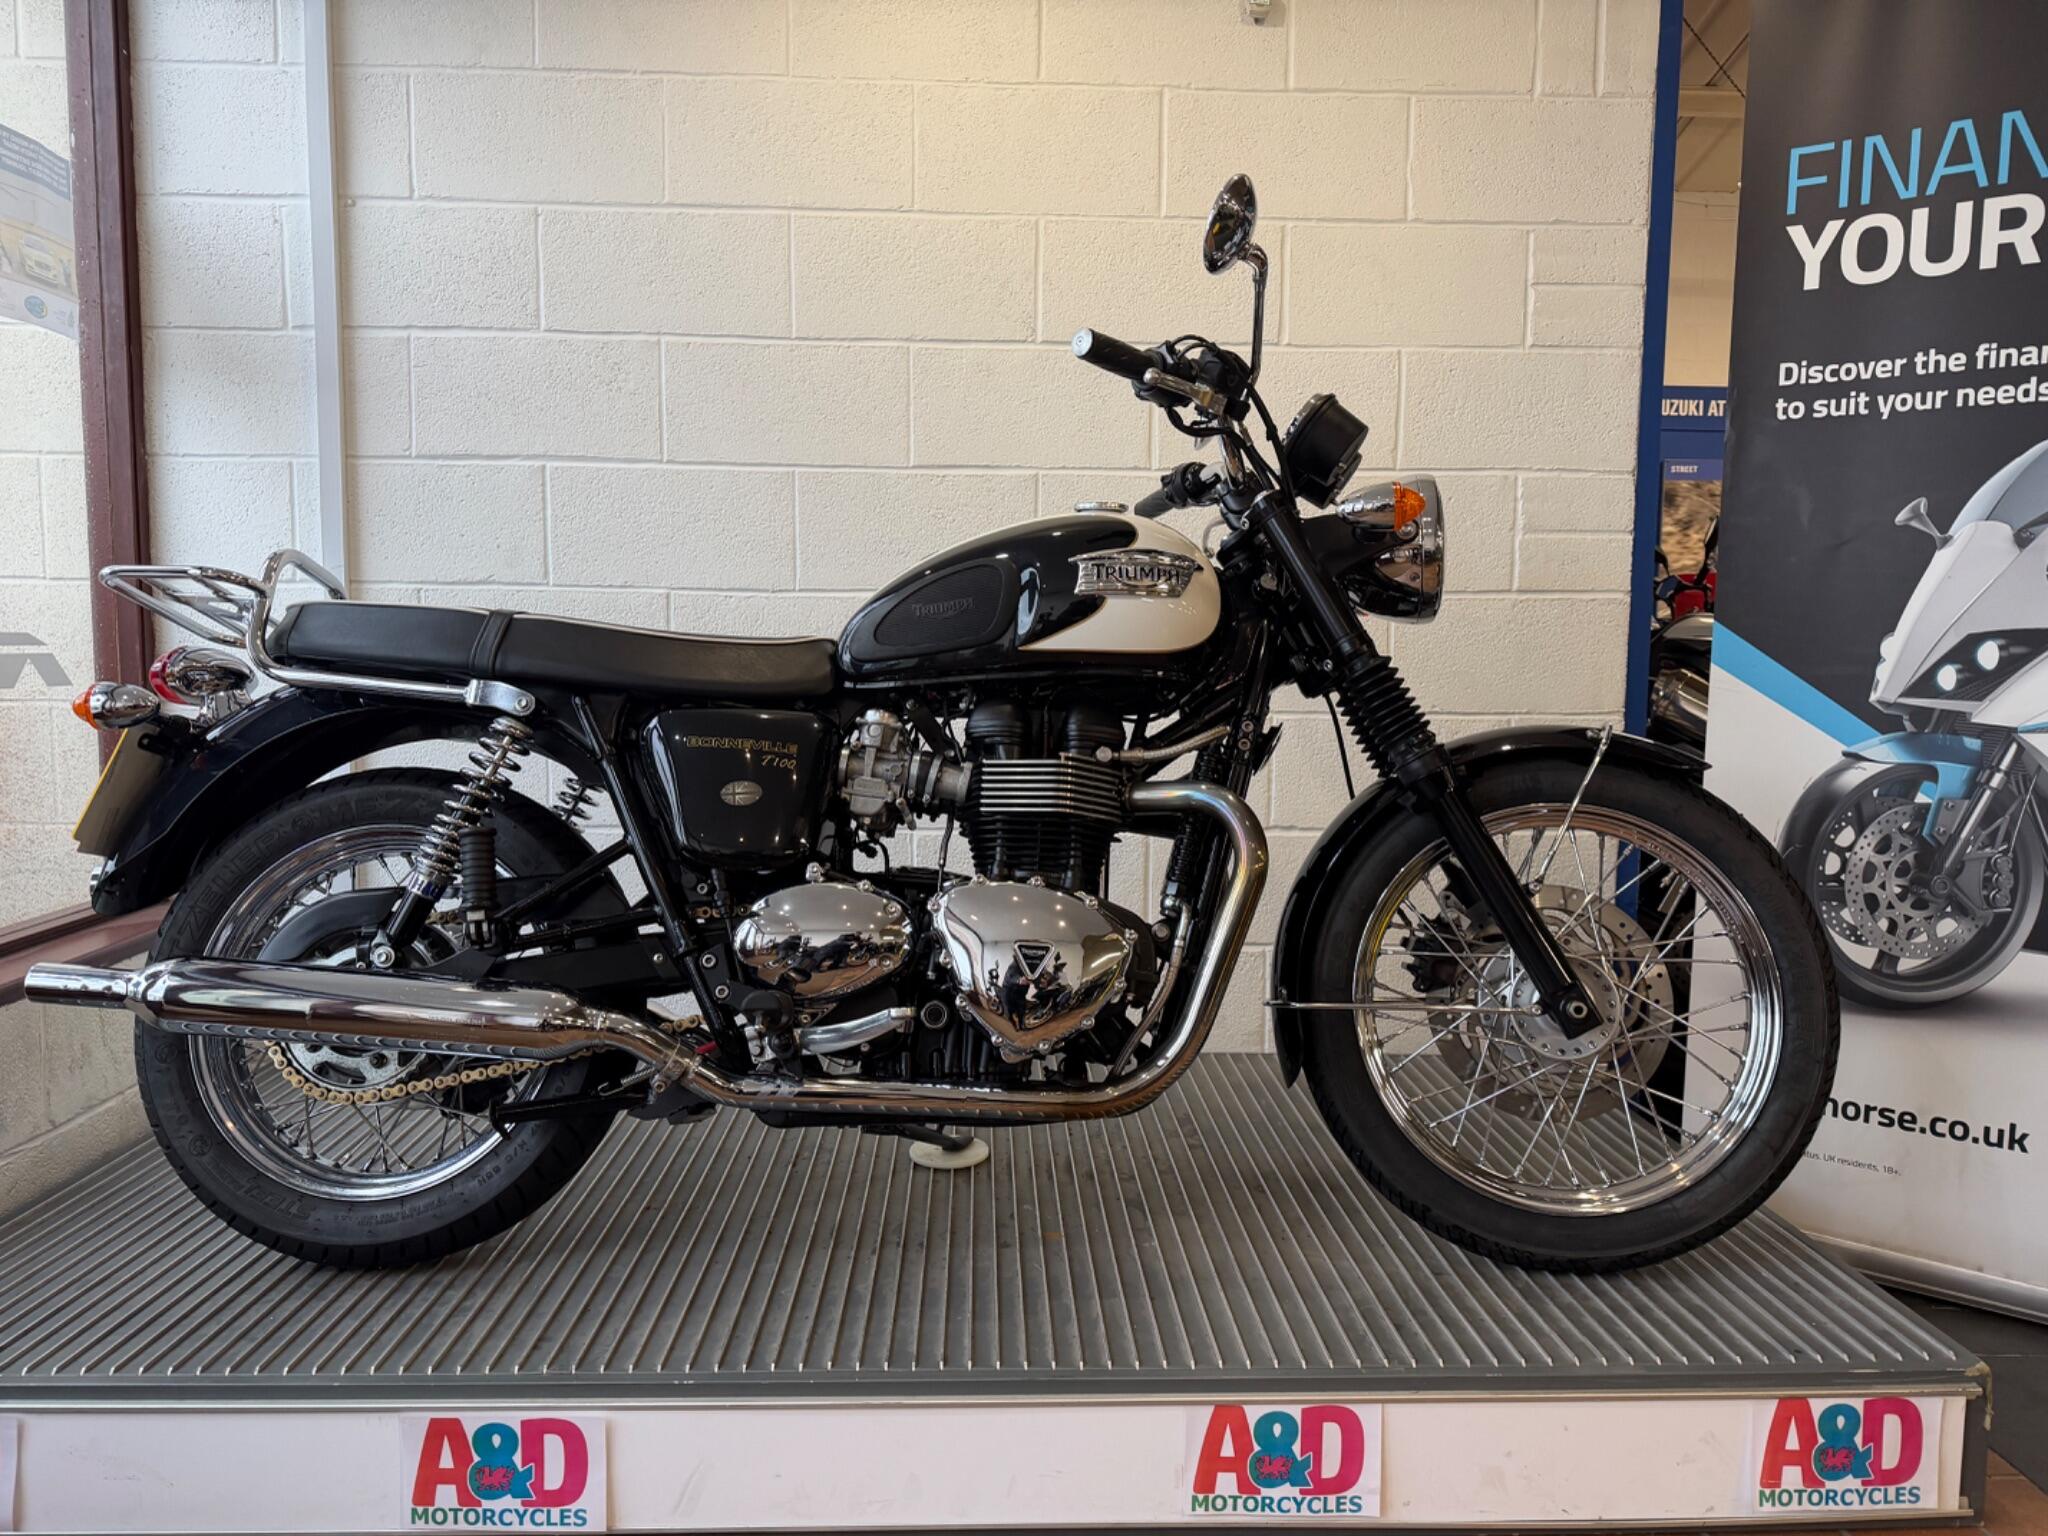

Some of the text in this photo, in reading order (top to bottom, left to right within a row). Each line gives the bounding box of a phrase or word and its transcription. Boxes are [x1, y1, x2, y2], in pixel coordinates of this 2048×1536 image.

[1786, 110, 2048, 215] FINAN
[1785, 193, 2046, 291] YOUR
[1778, 357, 1908, 387] Discover
[1914, 348, 1967, 375] the
[1661, 398, 1727, 417] UZUKI AT
[1775, 398, 1805, 420] to
[1812, 391, 1869, 418] suit
[1877, 389, 1948, 420] your
[1091, 563, 1181, 589] TRIUMPH
[687, 735, 798, 753] BONNEVILLE
[761, 754, 797, 769] T100
[1192, 1404, 1365, 1496] A&D
[1759, 1396, 1924, 1489] A&D
[412, 1417, 589, 1508] A&D
[1191, 1494, 1363, 1514] MOTORCYCLES
[1758, 1486, 1921, 1508] MOTORCYCLES
[410, 1507, 588, 1527] MOTORCYCLES
